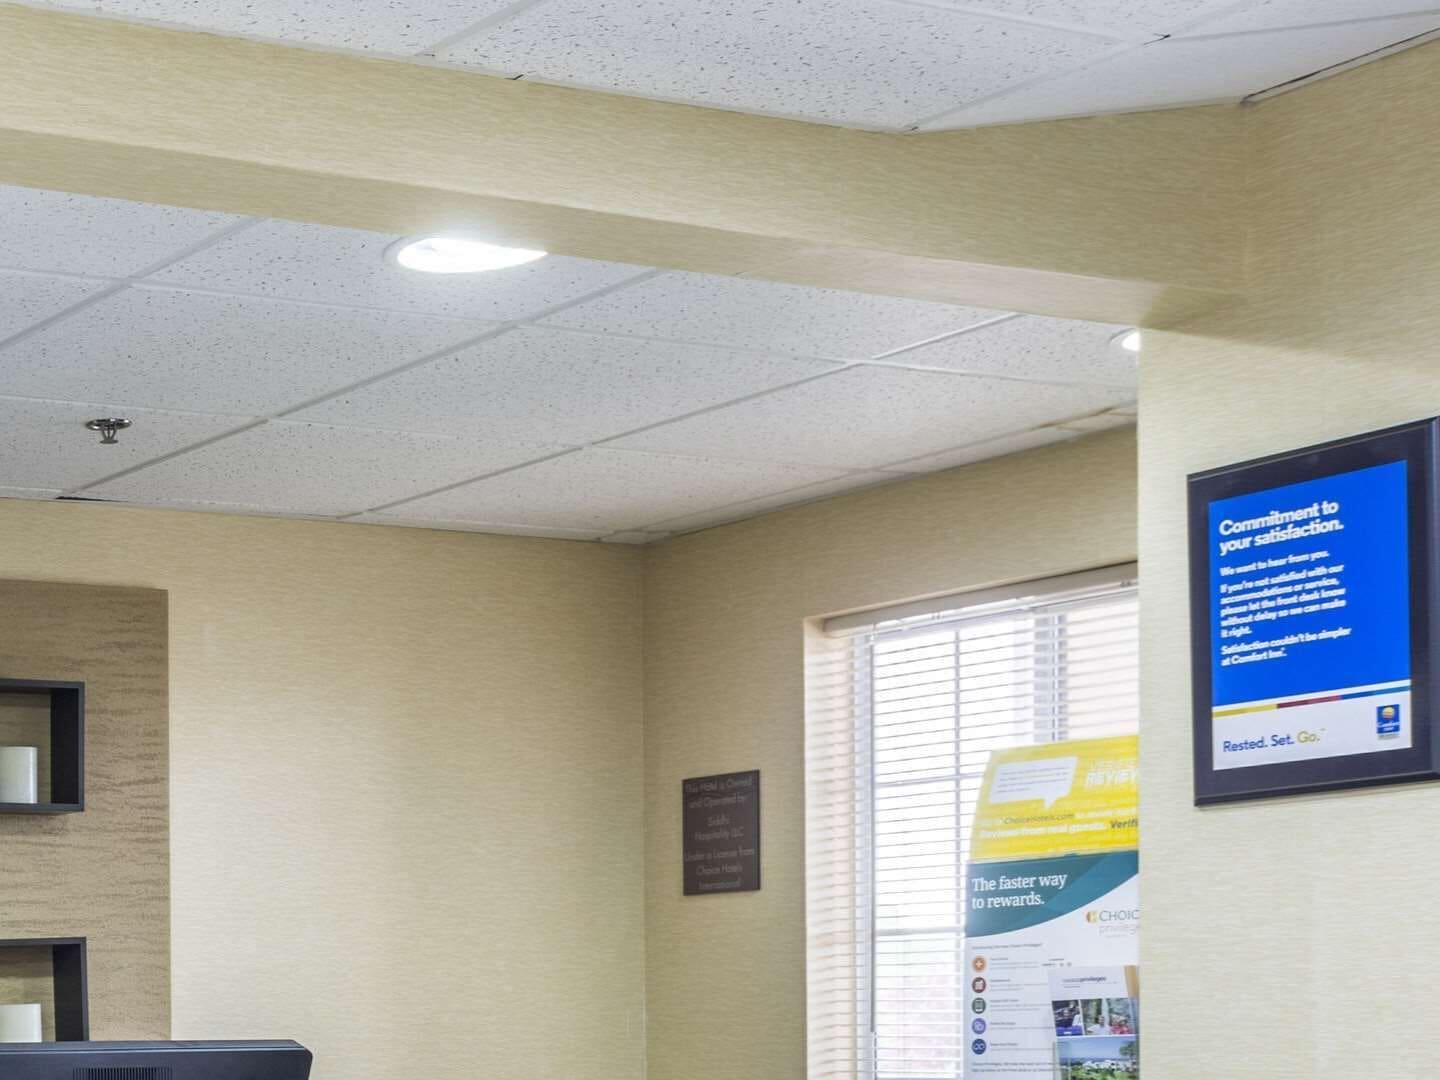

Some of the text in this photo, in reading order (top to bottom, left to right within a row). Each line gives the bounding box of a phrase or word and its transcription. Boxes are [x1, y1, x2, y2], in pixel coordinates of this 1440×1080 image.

[1219, 500, 1339, 536] Commitment to
[1219, 518, 1345, 557] your satisfaction.
[1230, 652, 1268, 665] Comfort
[1222, 735, 1269, 753] Rested.
[1270, 733, 1295, 748] Set.
[971, 873, 1068, 893] The faster way
[971, 891, 1046, 910] to rewards.
